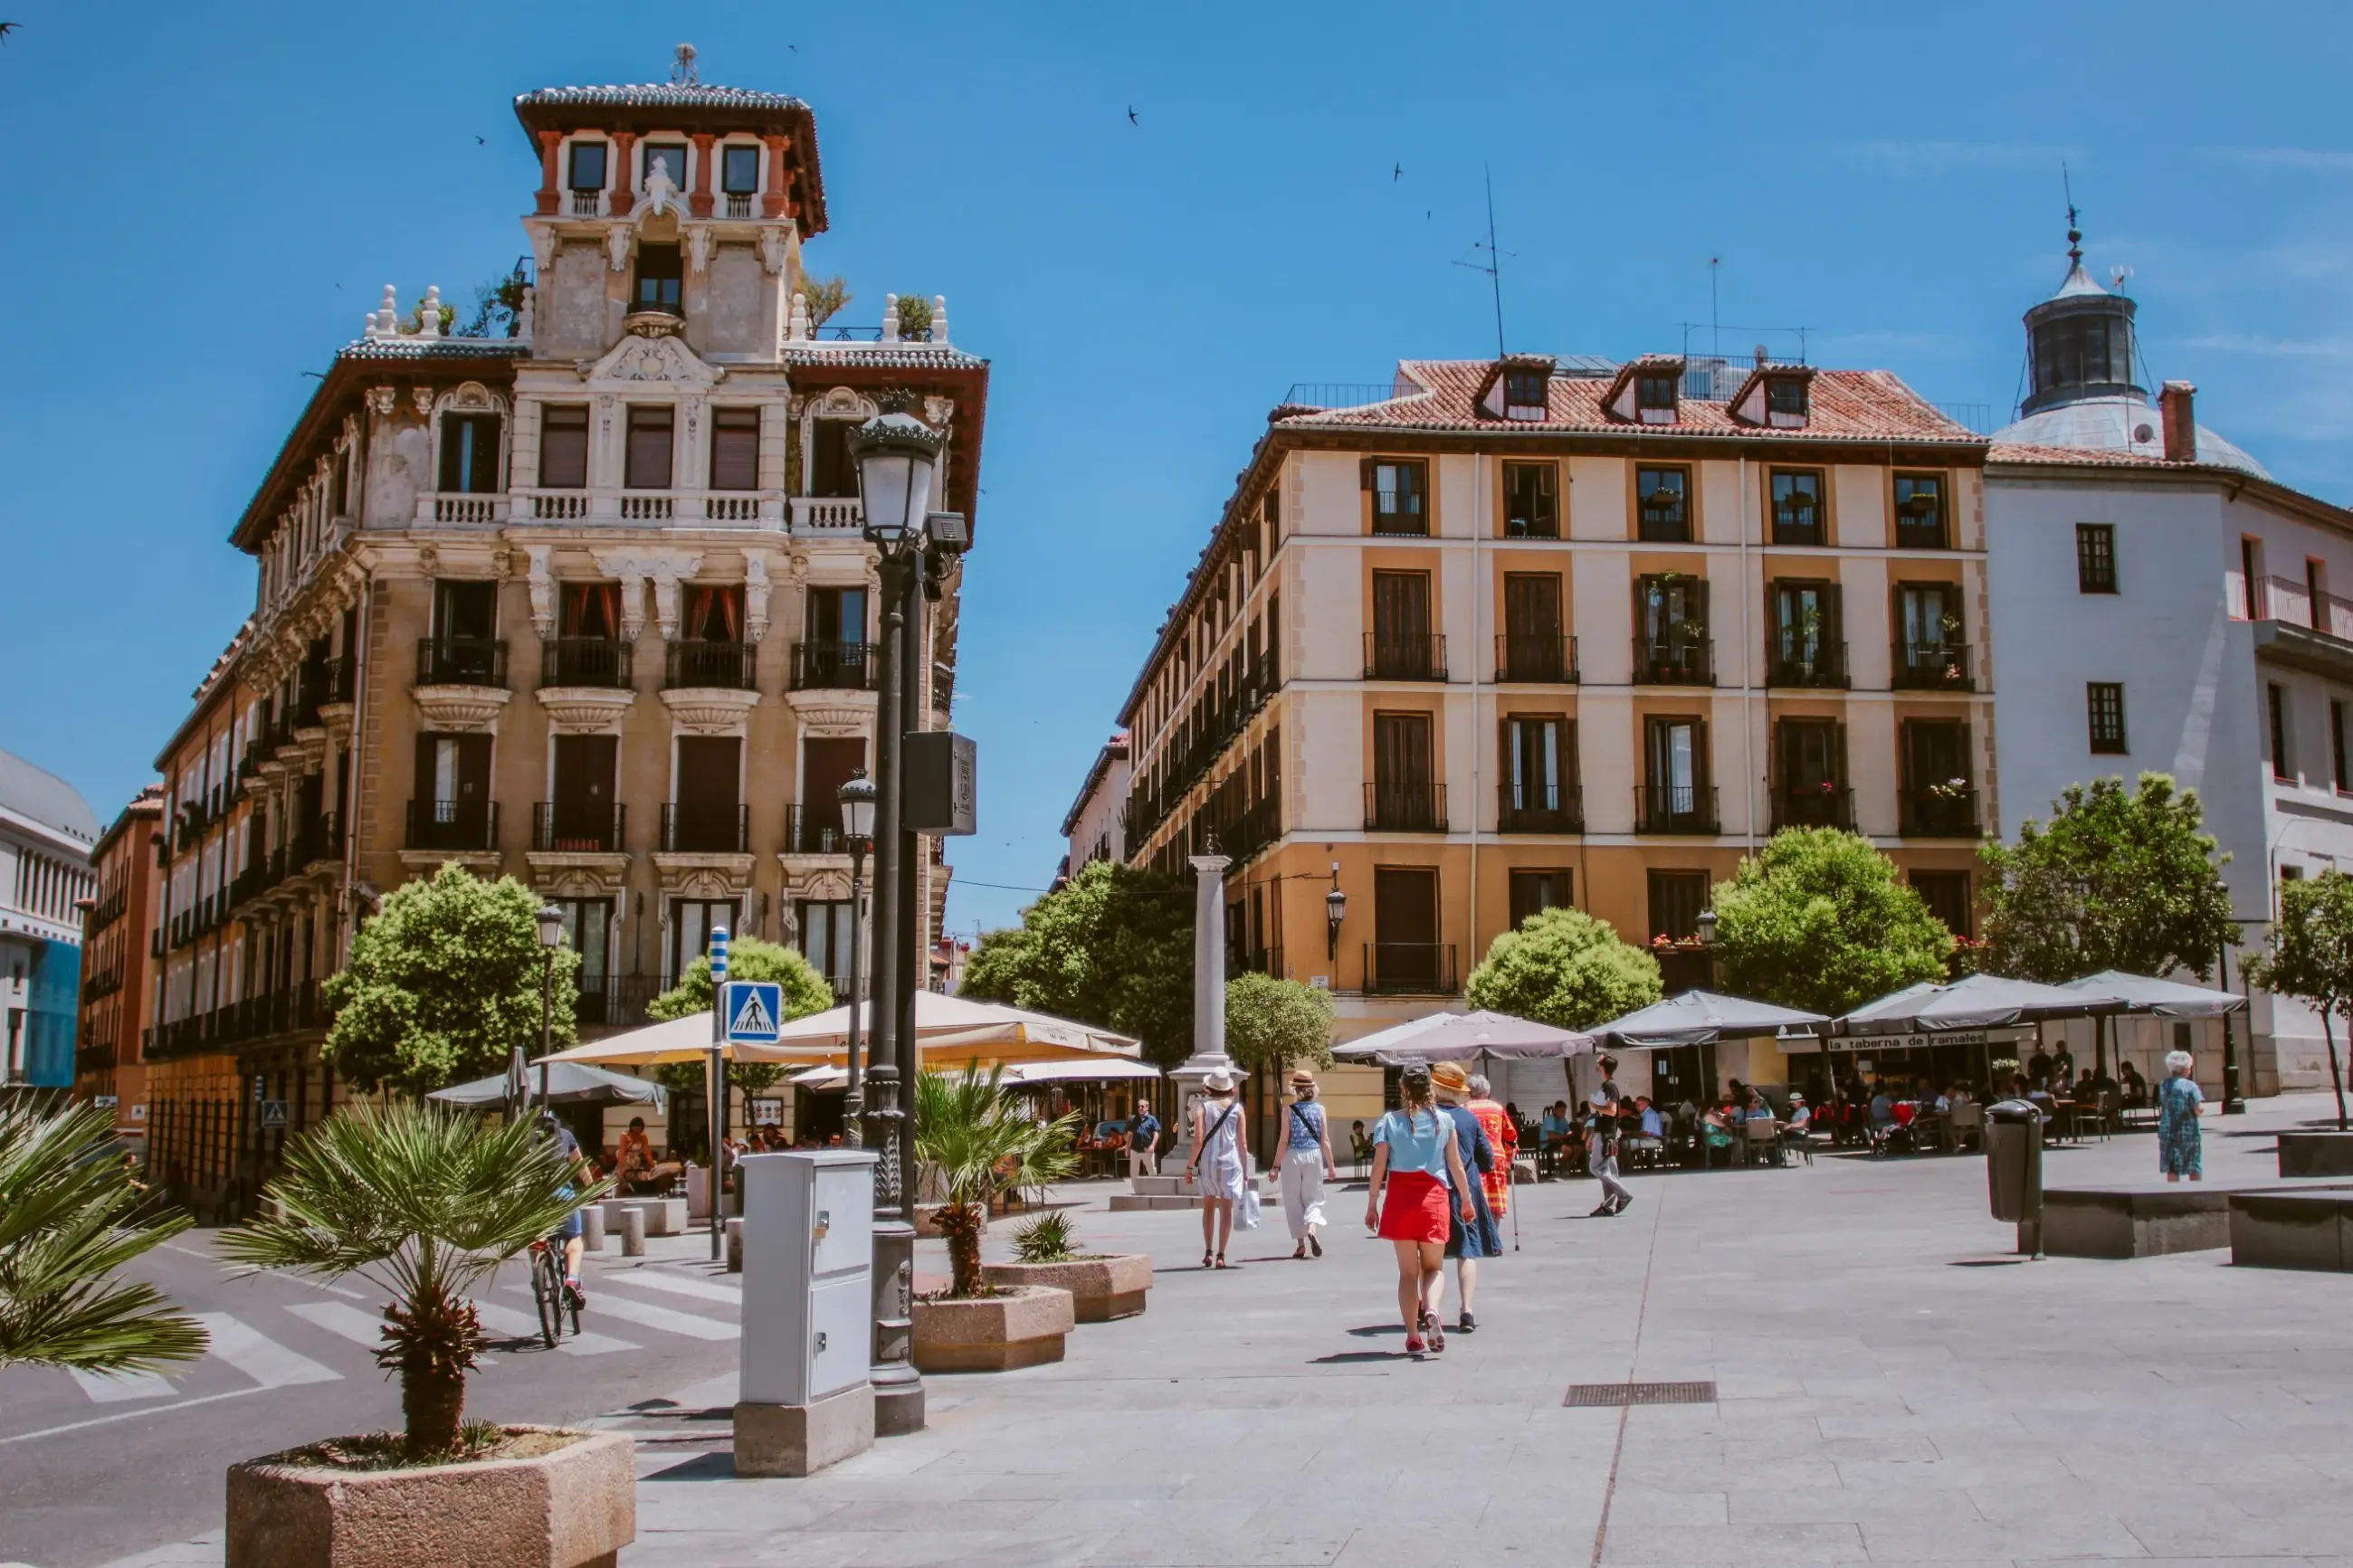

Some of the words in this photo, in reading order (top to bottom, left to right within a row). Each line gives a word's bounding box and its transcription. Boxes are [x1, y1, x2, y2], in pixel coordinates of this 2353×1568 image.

[1830, 1041, 1842, 1050] la
[1850, 1038, 1900, 1050] taberna
[1908, 1035, 1924, 1046] de
[1930, 1033, 1985, 1046] ramales
